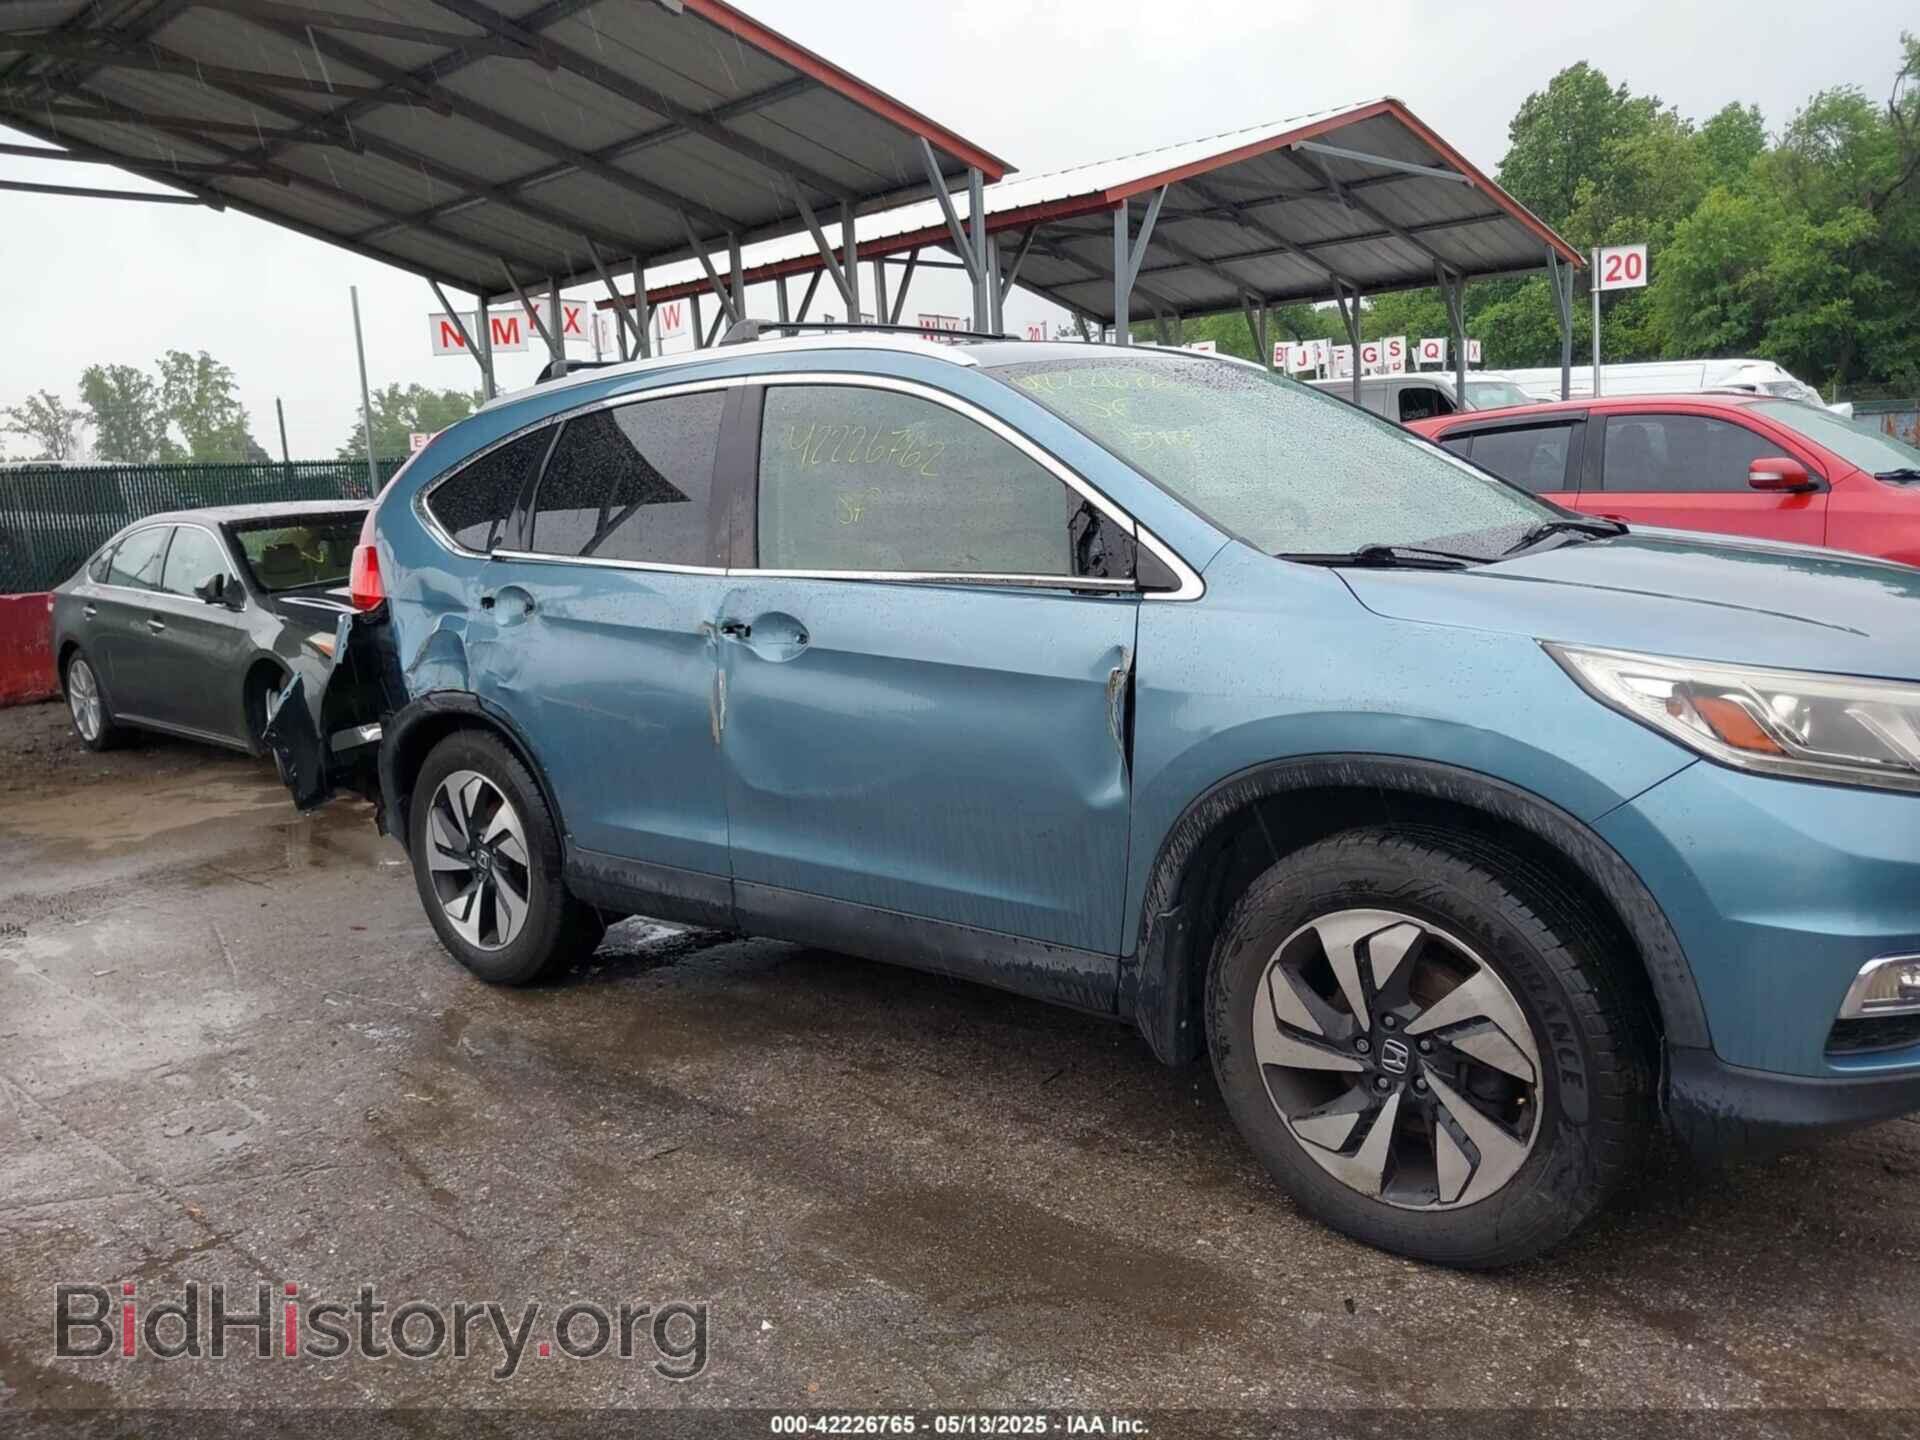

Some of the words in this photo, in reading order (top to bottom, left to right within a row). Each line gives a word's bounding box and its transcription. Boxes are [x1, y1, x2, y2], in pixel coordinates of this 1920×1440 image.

[1605, 252, 1642, 282] 20
[563, 305, 581, 334] X
[663, 302, 681, 331] W
[440, 320, 466, 348] N
[491, 317, 520, 345] M
[1297, 350, 1308, 366] J
[1362, 347, 1378, 363] G
[1389, 341, 1401, 357] S
[1424, 342, 1439, 359] Q
